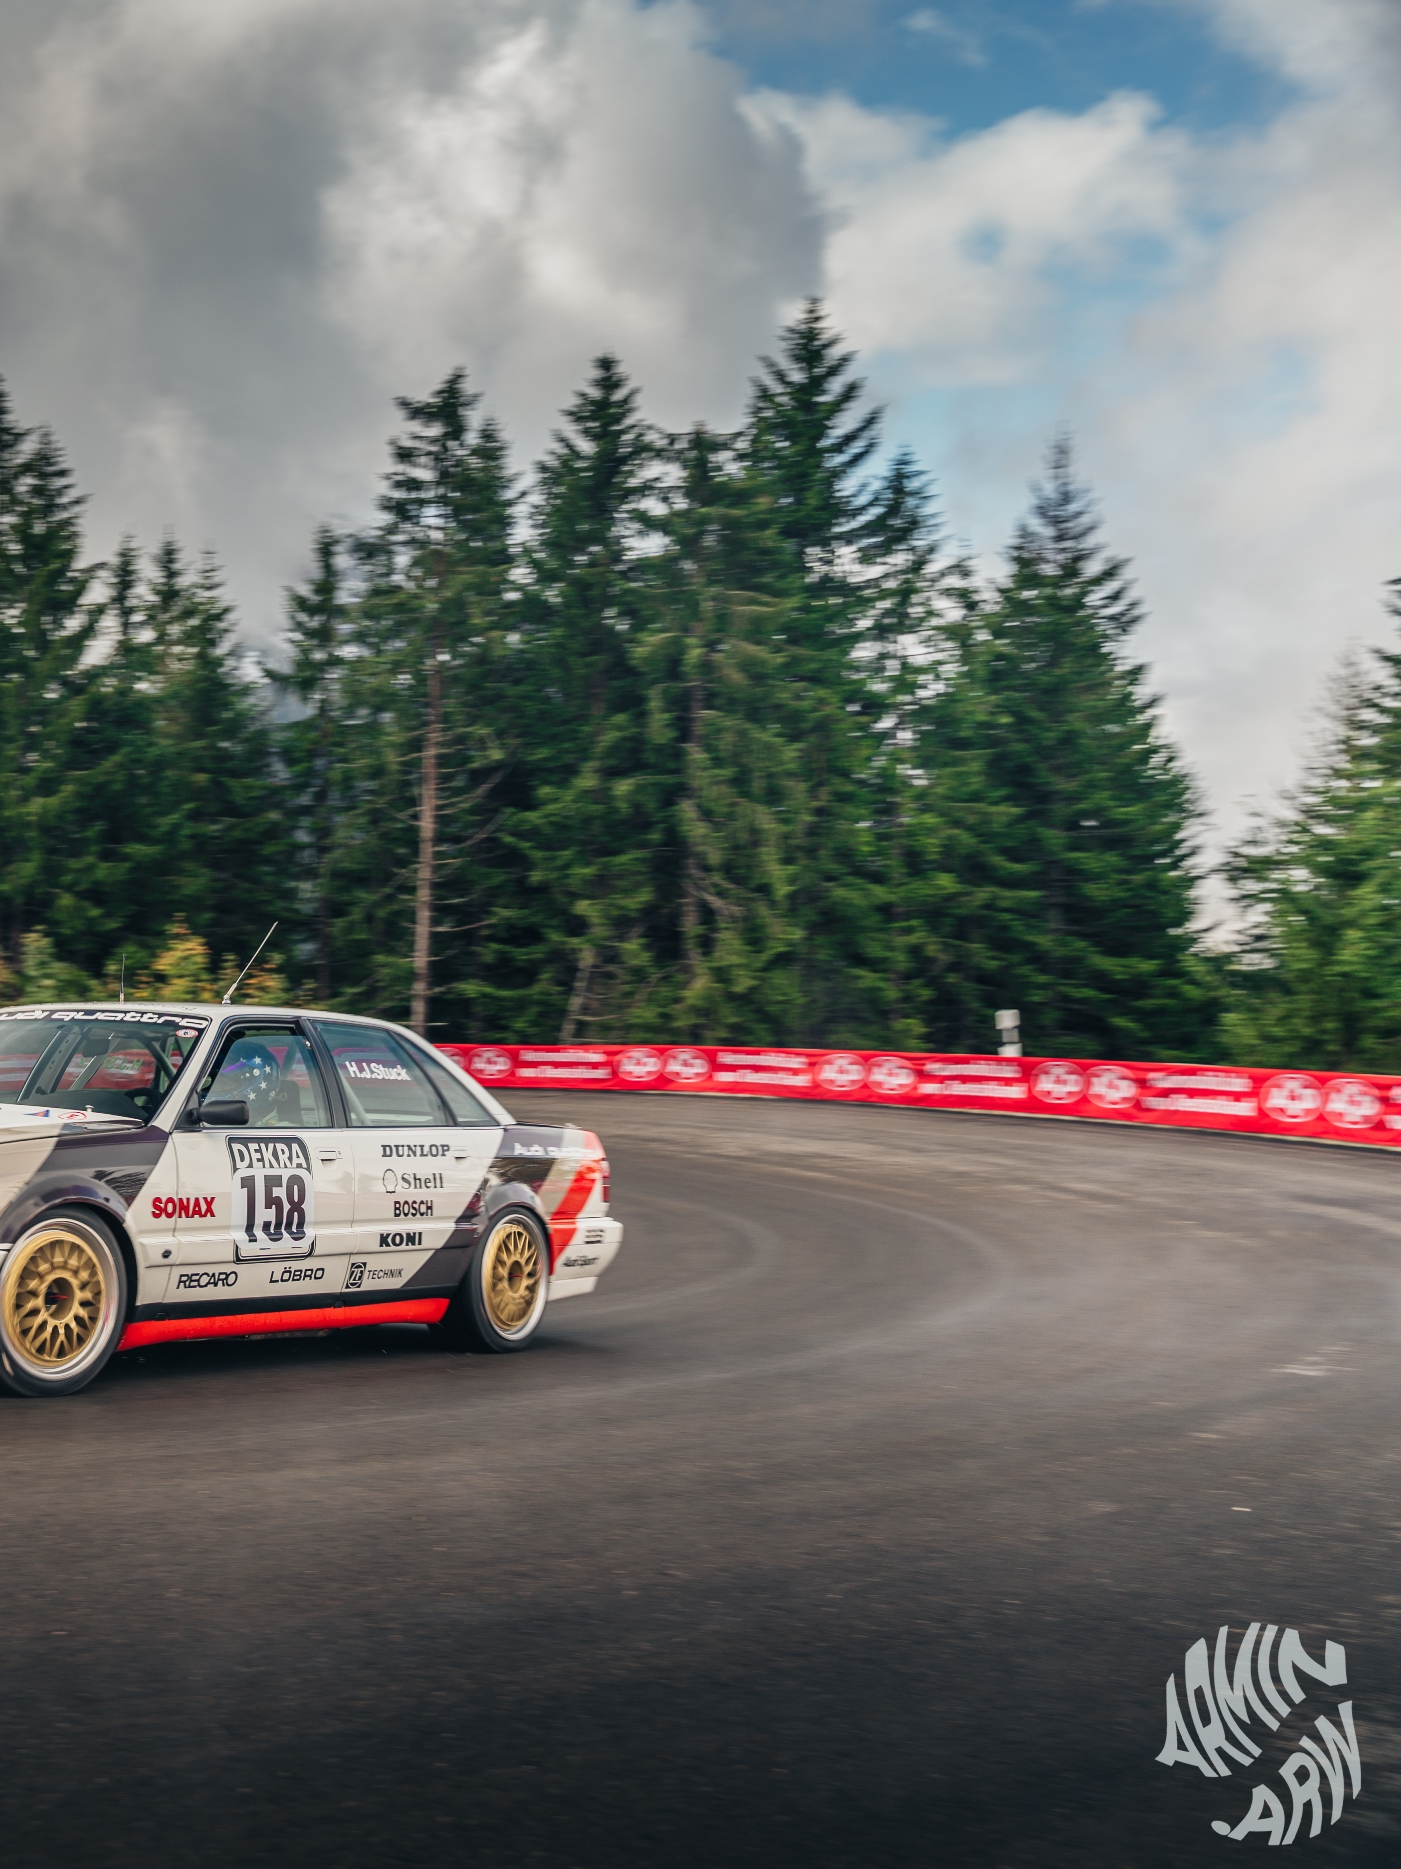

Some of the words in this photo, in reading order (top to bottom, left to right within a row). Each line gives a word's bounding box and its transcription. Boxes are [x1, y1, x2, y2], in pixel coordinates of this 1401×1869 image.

[51, 1011, 210, 1029] quattro
[345, 1061, 412, 1081] H.J.Stuck
[231, 1142, 308, 1169] DEKRA
[380, 1144, 451, 1158] DUNLOP
[401, 1172, 445, 1190] Shell
[151, 1196, 216, 1219] SONAX
[239, 1174, 307, 1243] 158
[393, 1199, 434, 1218] BOSCH
[379, 1231, 423, 1248] KONI
[176, 1270, 239, 1290] RECARO
[269, 1266, 326, 1284] LÖBRO
[366, 1267, 404, 1281] TECHNIK
